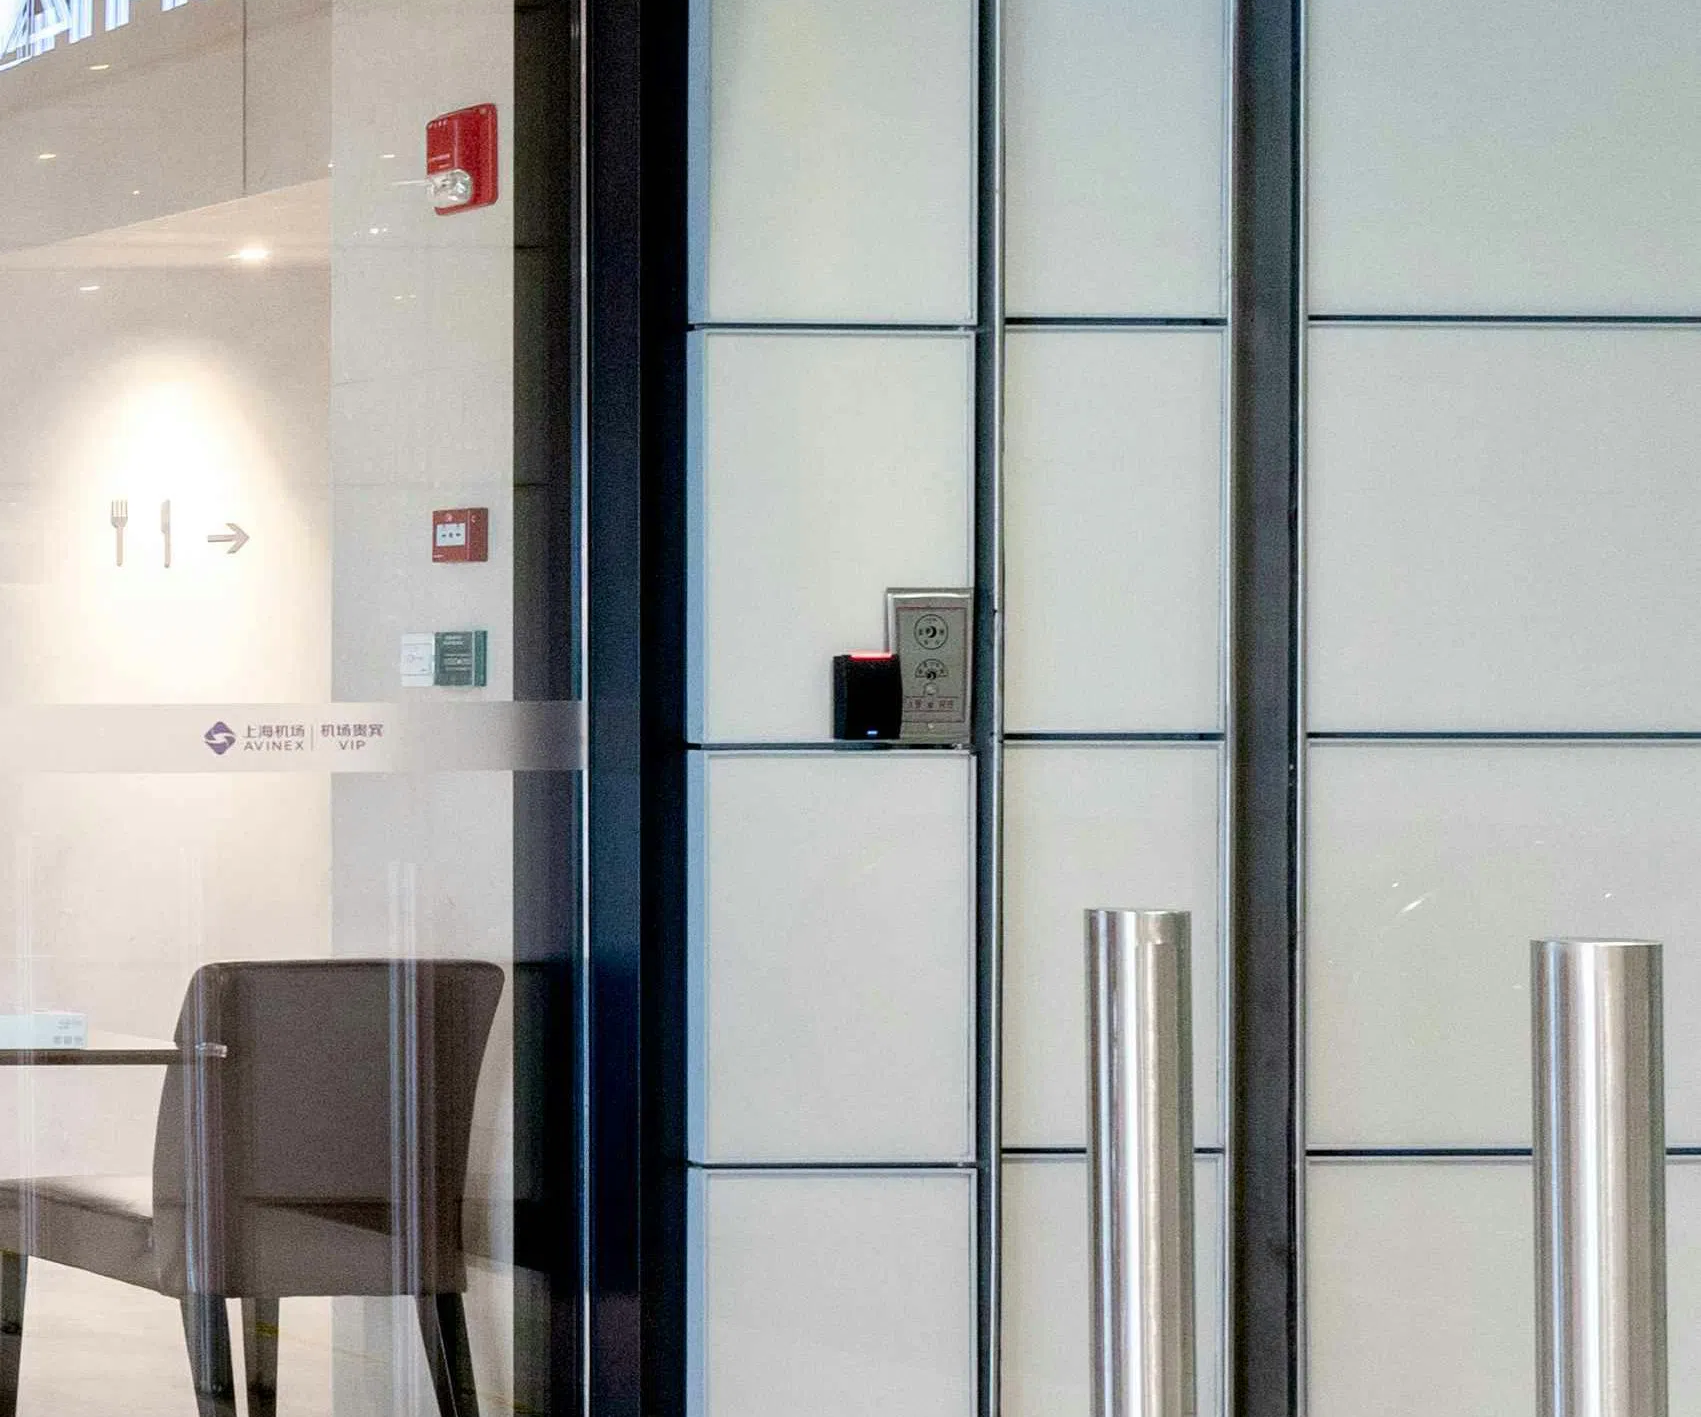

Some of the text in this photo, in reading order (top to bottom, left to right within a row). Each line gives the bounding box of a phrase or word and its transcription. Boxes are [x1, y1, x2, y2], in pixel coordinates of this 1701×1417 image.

[243, 724, 305, 738] 上海机场
[243, 740, 367, 751] AVINEX VIP
